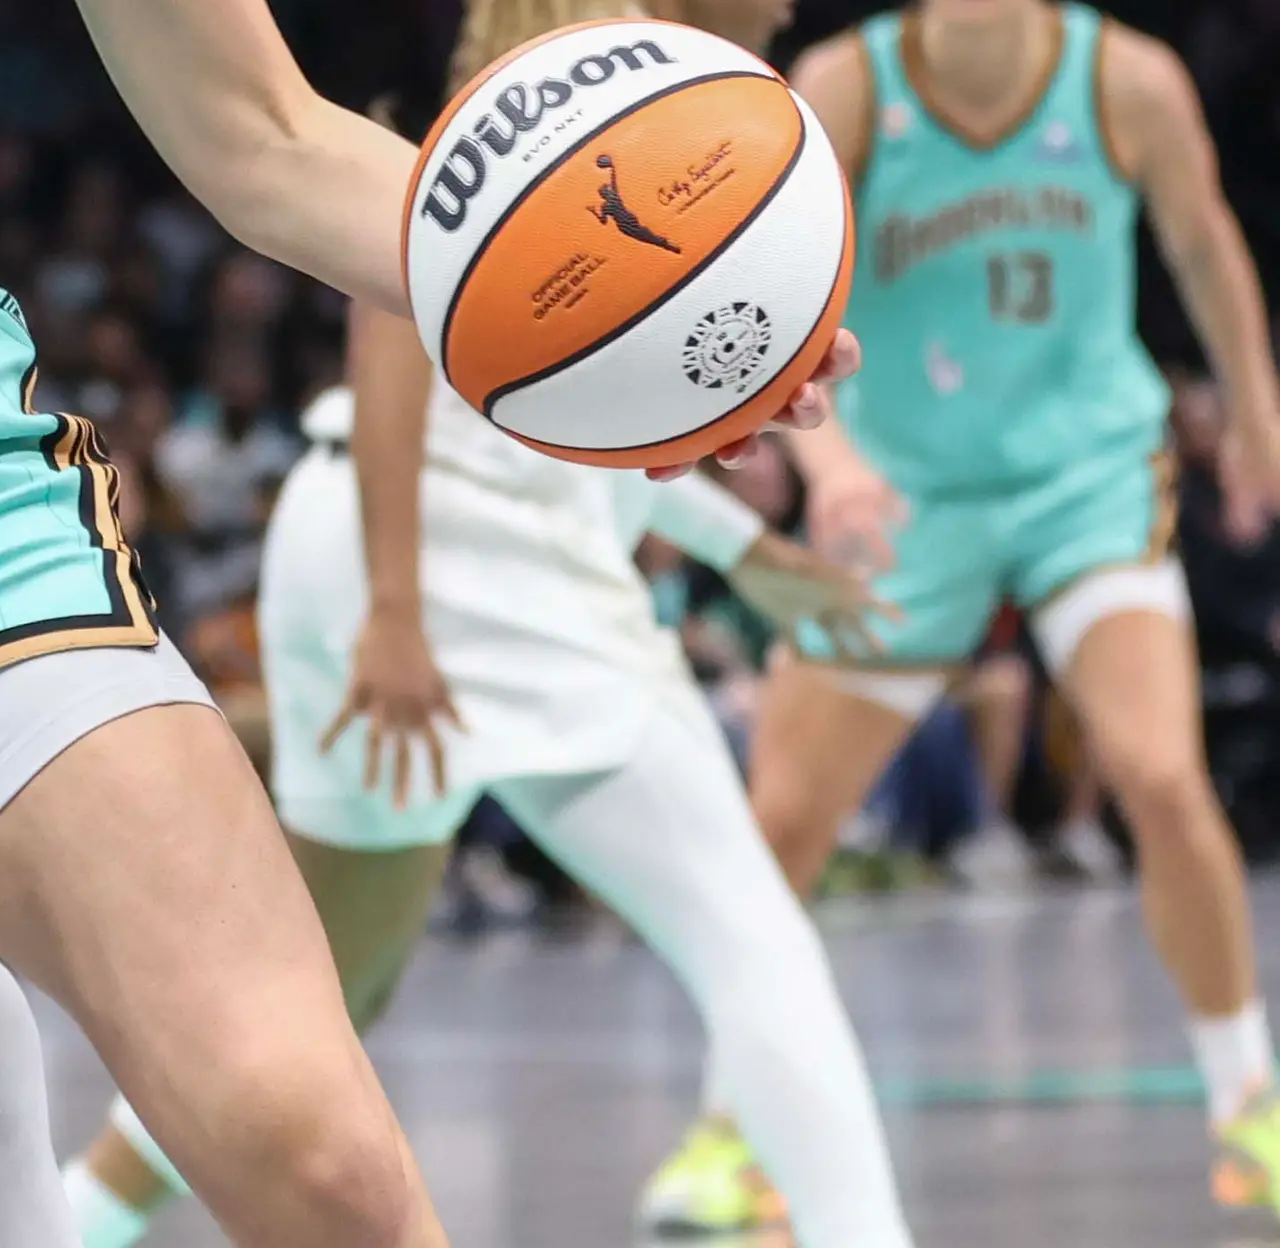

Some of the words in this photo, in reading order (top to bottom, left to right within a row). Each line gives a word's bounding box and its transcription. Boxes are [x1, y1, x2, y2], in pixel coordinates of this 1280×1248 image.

[422, 38, 680, 234] Wilson
[531, 253, 589, 304] OFFICIAL
[533, 284, 571, 321] GAME
[570, 257, 608, 288] BALL
